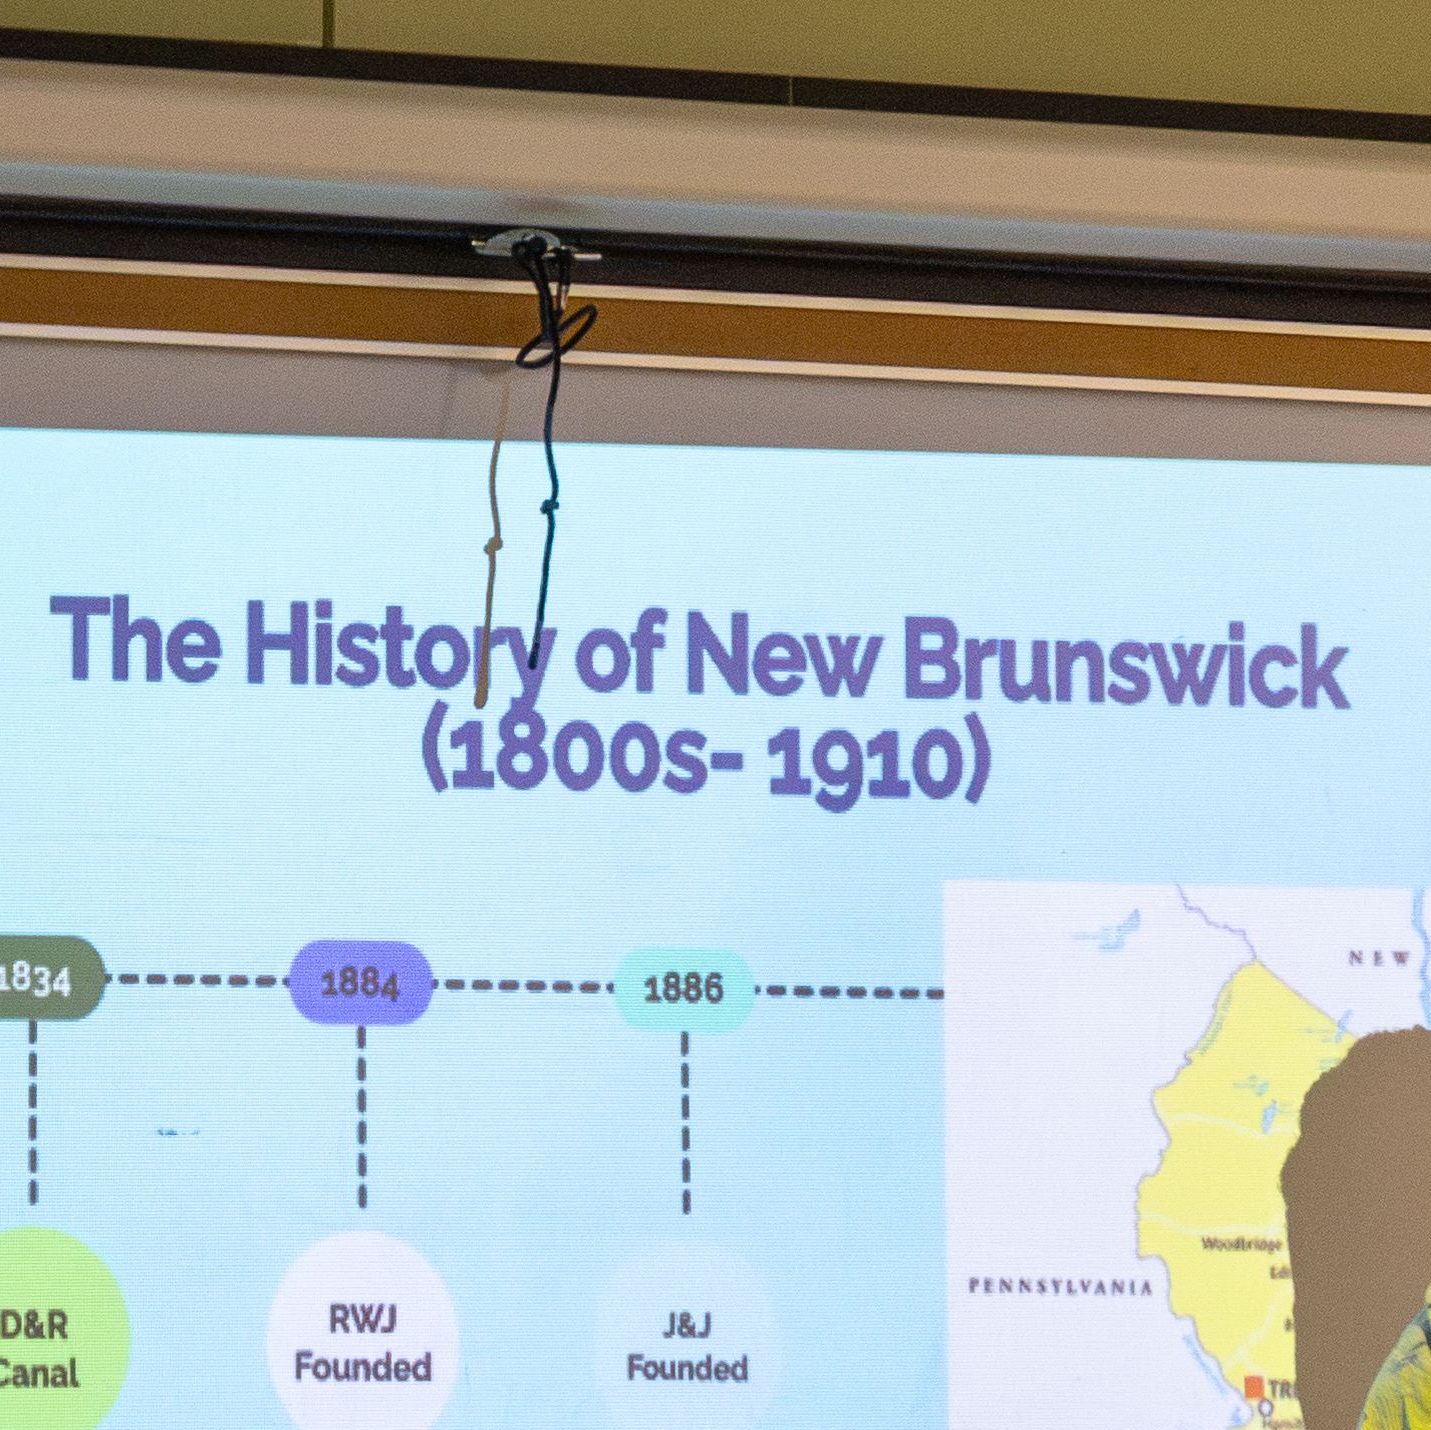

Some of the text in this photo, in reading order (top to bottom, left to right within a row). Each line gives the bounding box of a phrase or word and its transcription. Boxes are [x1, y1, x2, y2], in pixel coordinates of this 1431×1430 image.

[49, 592, 1352, 718] The History of New Brunswick
[421, 696, 992, 815] (1800s- 1910)
[1348, 949, 1409, 968] NEW
[321, 964, 402, 1004] 1884
[644, 970, 725, 1005] 1886
[1201, 1235, 1283, 1254] Woodbridge
[969, 1276, 1154, 1297] PENNSYLVANIA
[0, 1308, 69, 1340] D&R
[329, 1302, 397, 1334] RWJ
[662, 1310, 712, 1340] J&J
[294, 1349, 433, 1383] Founded
[627, 1353, 749, 1383] Founded
